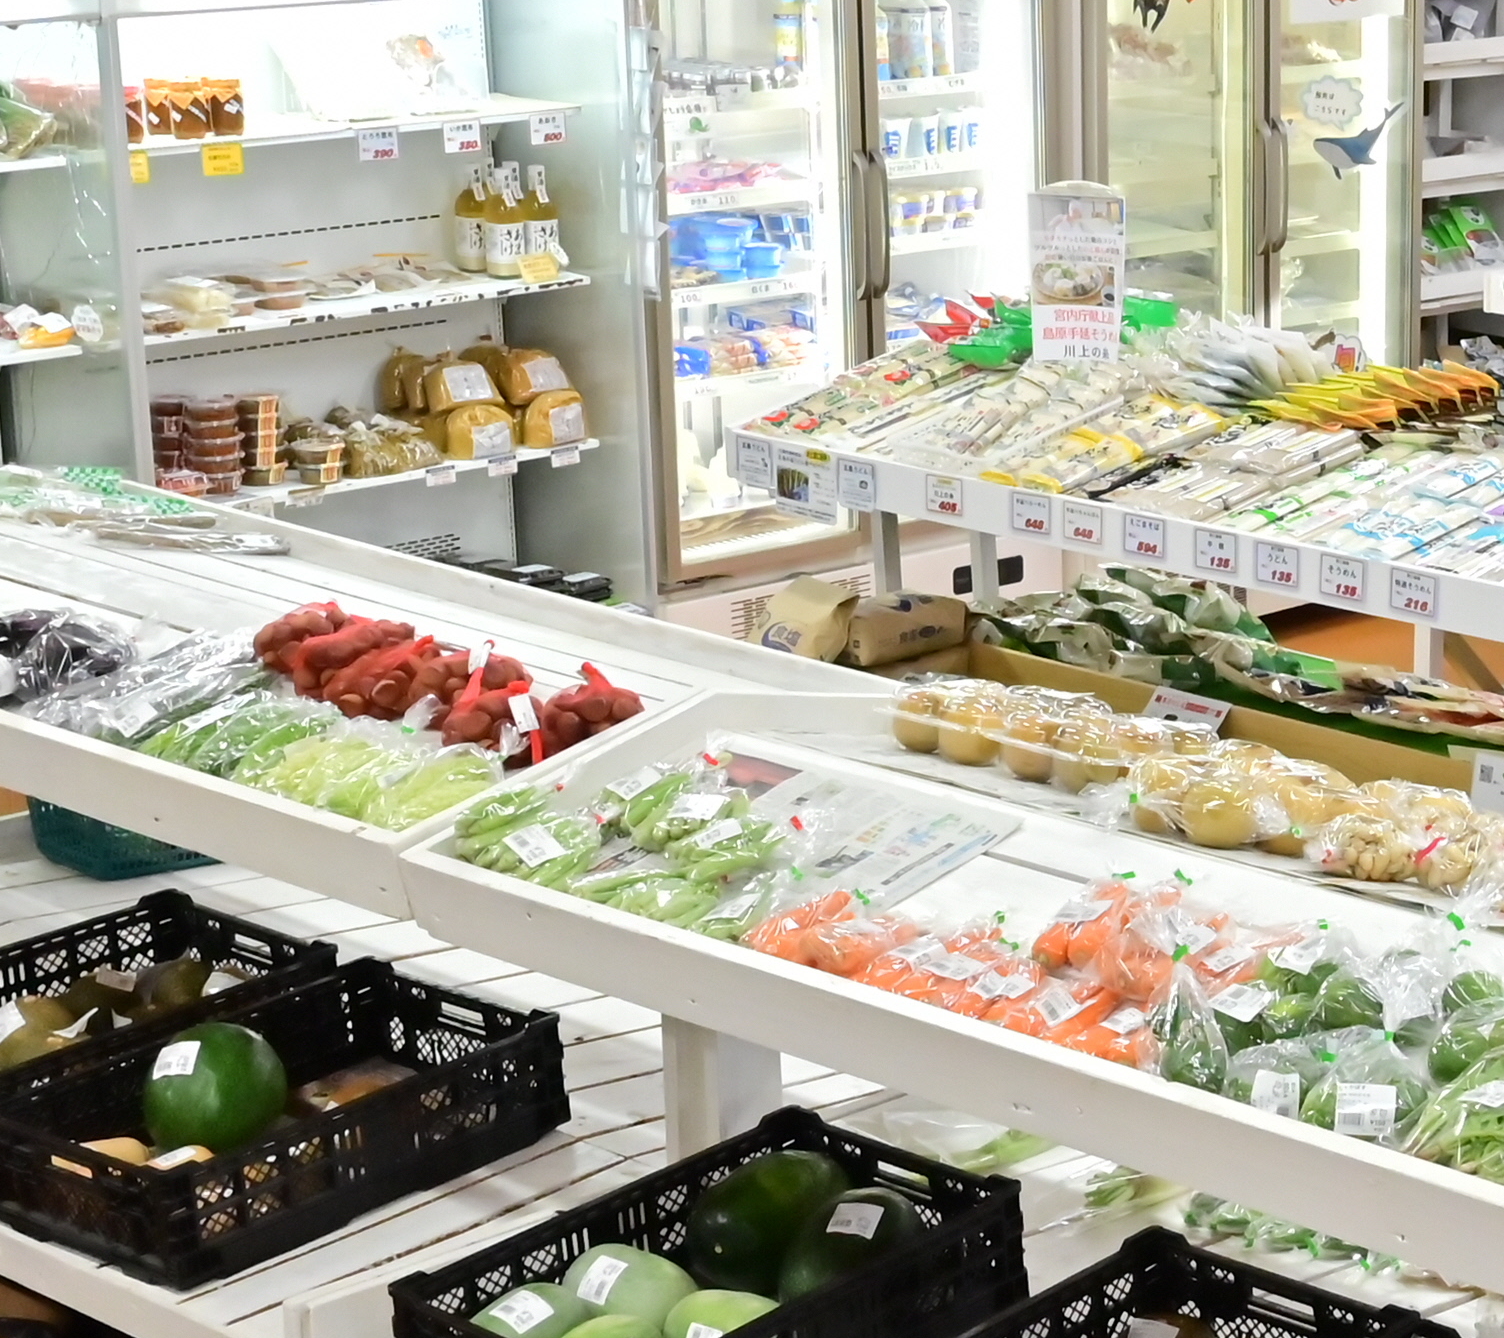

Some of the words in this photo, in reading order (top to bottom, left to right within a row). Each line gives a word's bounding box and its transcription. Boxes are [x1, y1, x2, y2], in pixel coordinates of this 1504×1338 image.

[1209, 556, 1232, 570] 135
[1267, 553, 1289, 566] うどん
[1270, 569, 1293, 584] 135
[1327, 564, 1357, 580] そうめん
[1335, 583, 1359, 598] 135
